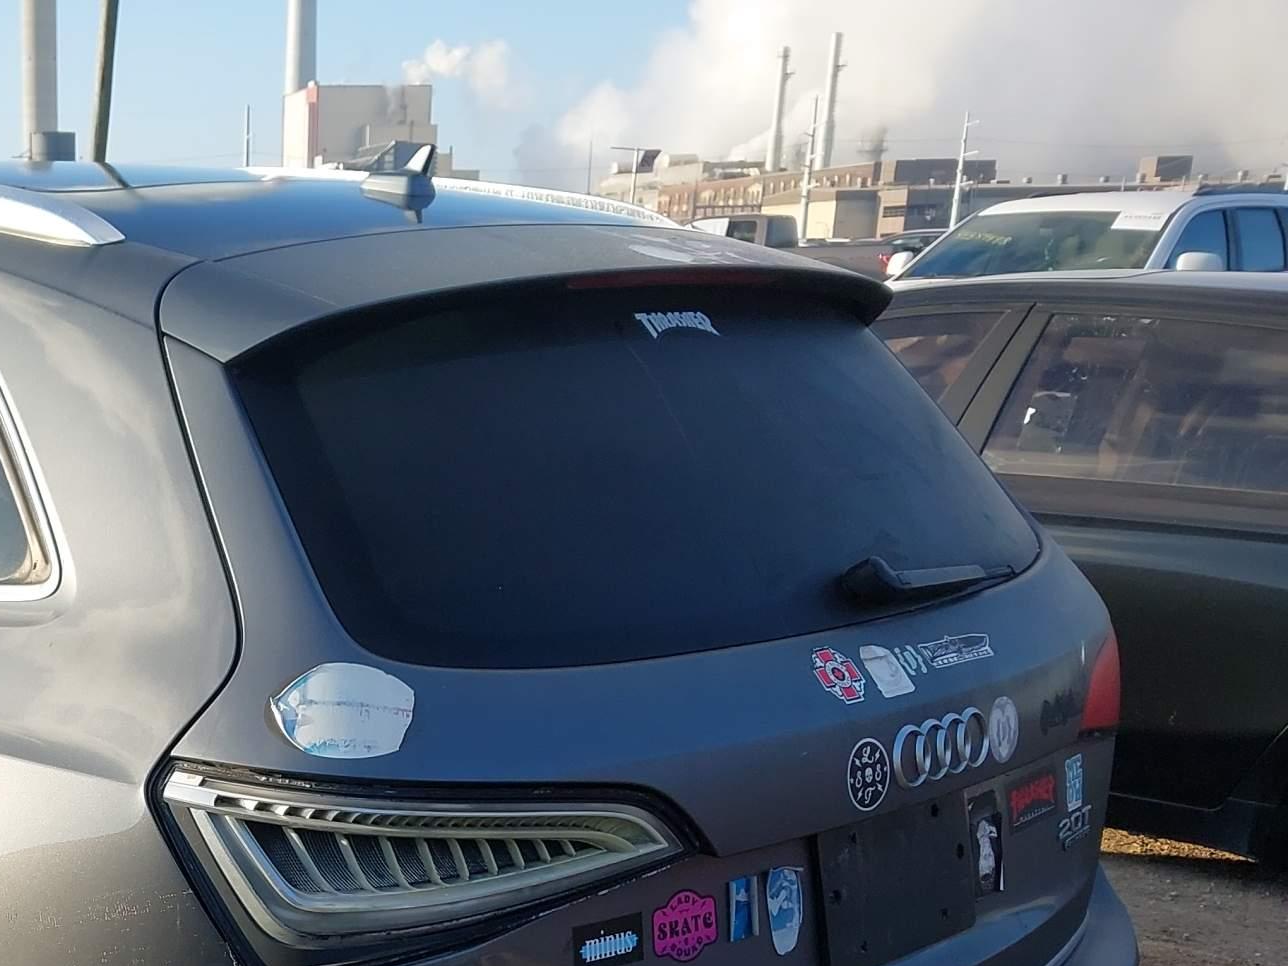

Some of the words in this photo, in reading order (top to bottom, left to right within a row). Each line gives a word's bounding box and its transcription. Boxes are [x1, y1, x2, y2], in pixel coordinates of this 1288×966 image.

[670, 894, 698, 912] LADY
[657, 911, 714, 941] SKATE
[584, 928, 634, 963] minus
